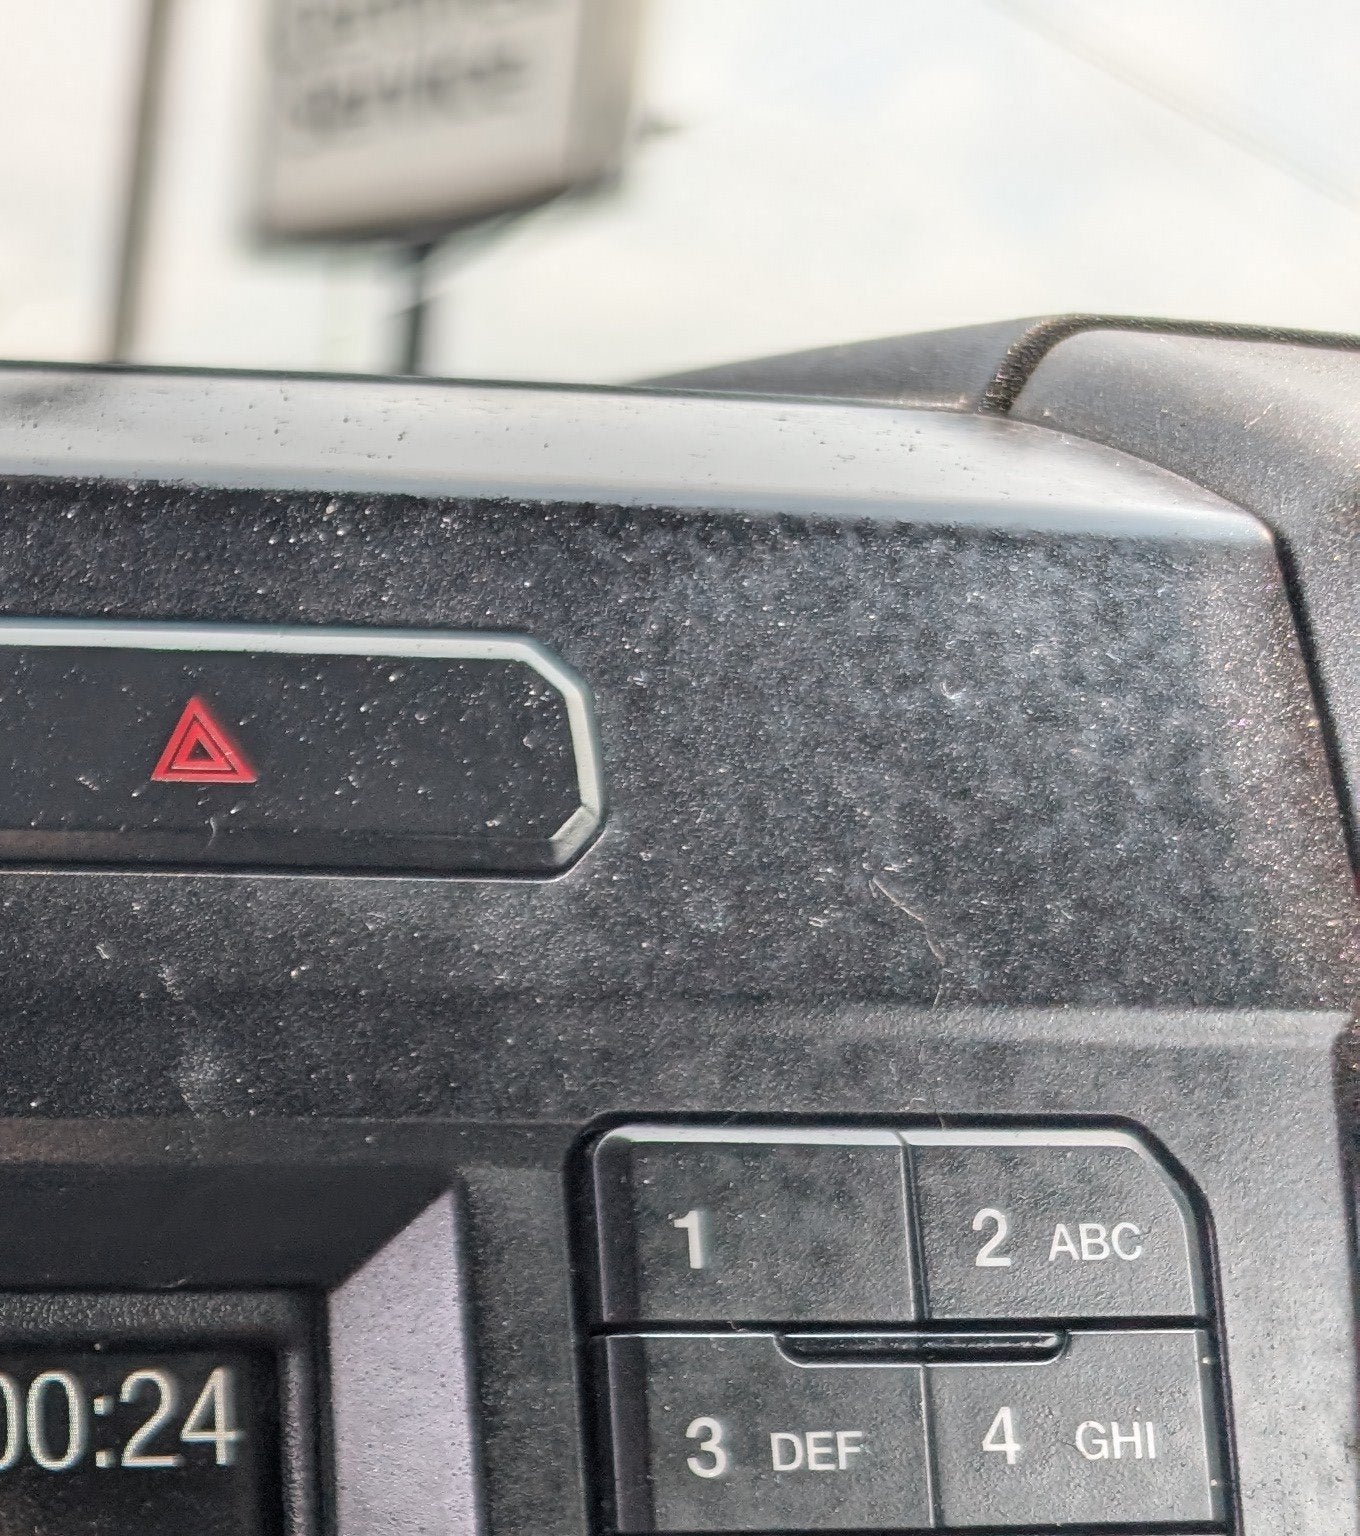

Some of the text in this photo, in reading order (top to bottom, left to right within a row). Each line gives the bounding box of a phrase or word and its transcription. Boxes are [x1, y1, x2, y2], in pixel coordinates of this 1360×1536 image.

[673, 1209, 704, 1270] 1
[972, 1208, 1144, 1267] 2 ABC
[685, 1417, 864, 1479] 3 DEF
[982, 1407, 1157, 1465] 4 GHI
